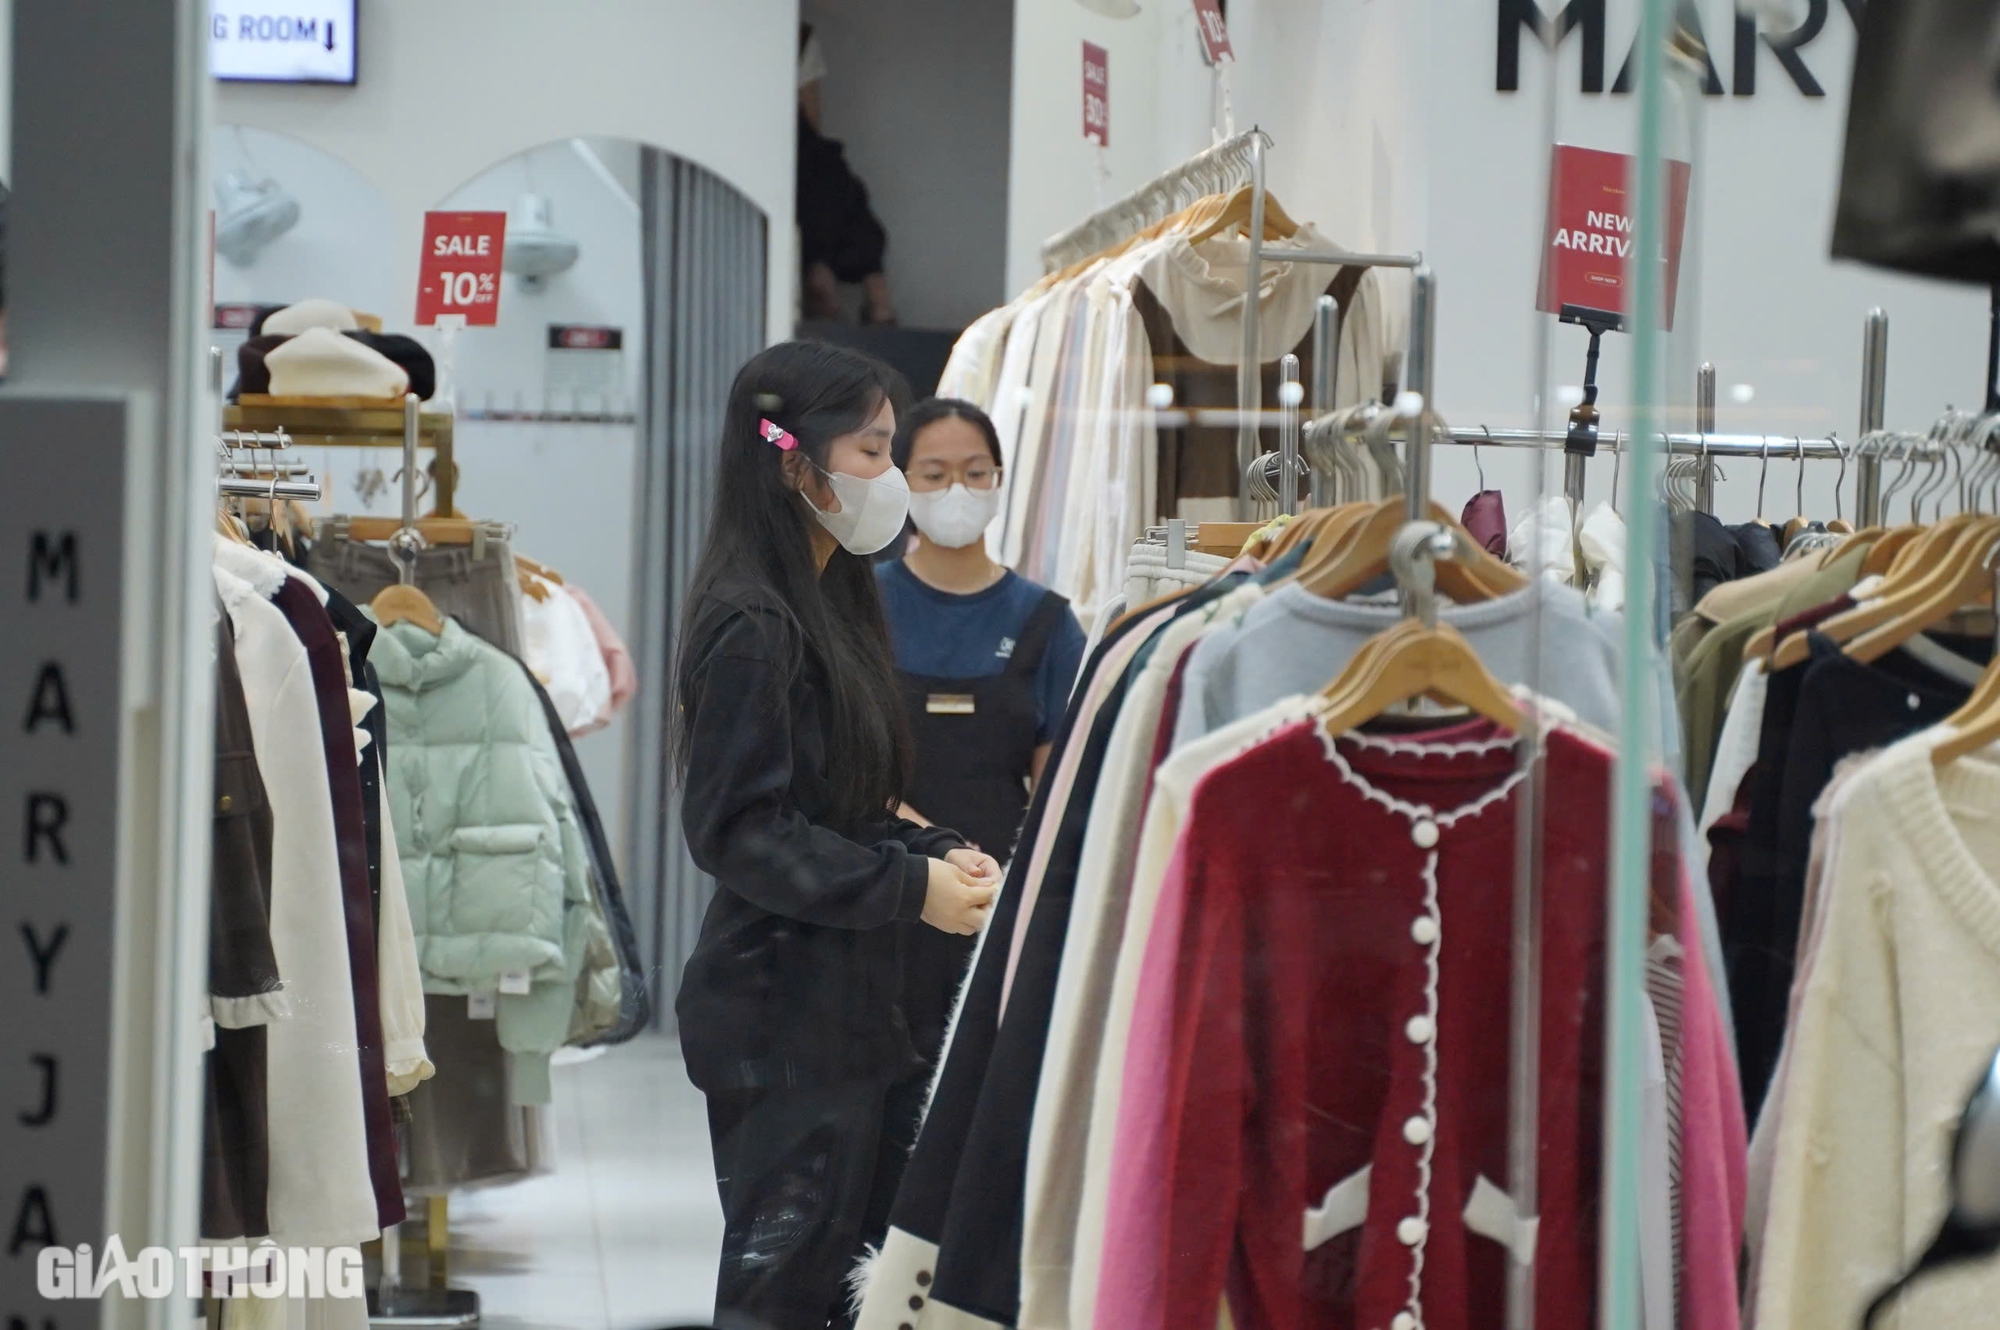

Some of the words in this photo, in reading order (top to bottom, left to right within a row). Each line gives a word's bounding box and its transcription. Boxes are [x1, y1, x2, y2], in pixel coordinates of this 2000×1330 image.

[238, 14, 316, 41] ROOM
[1496, 0, 1860, 96] MAR
[1587, 210, 1635, 233] NEW
[433, 235, 491, 256] SALE
[7, 528, 83, 1330] MARYJA
